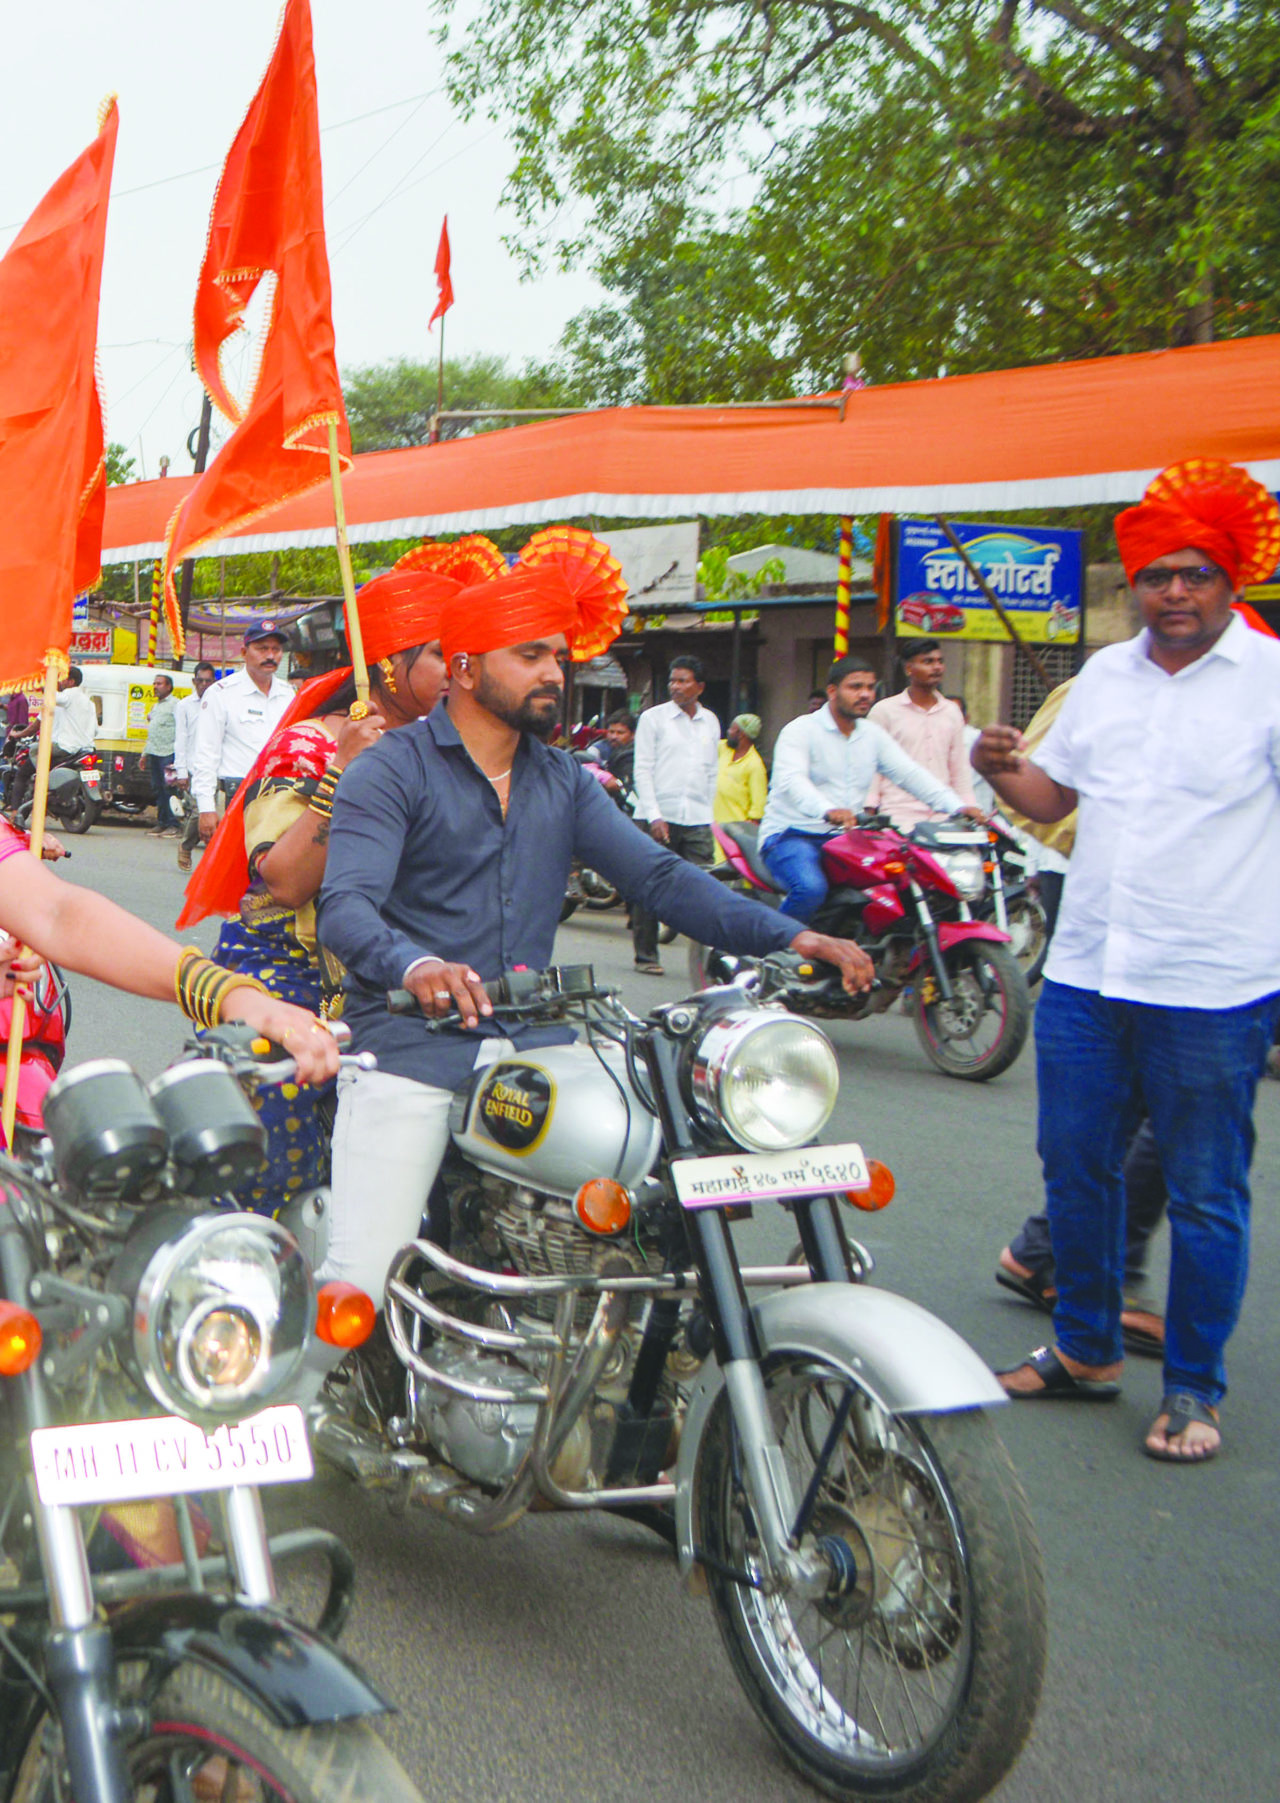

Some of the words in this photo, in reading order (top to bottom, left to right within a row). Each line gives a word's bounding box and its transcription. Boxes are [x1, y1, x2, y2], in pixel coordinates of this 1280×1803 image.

[924, 558, 983, 591] स्टार
[984, 551, 1060, 595] मोटर्स
[485, 1098, 533, 1127] ENFIELD
[491, 1082, 529, 1107] ROYAL
[53, 1446, 99, 1481] MH
[115, 1442, 138, 1476] 11
[153, 1436, 187, 1472] CV
[204, 1422, 292, 1471] 5550
